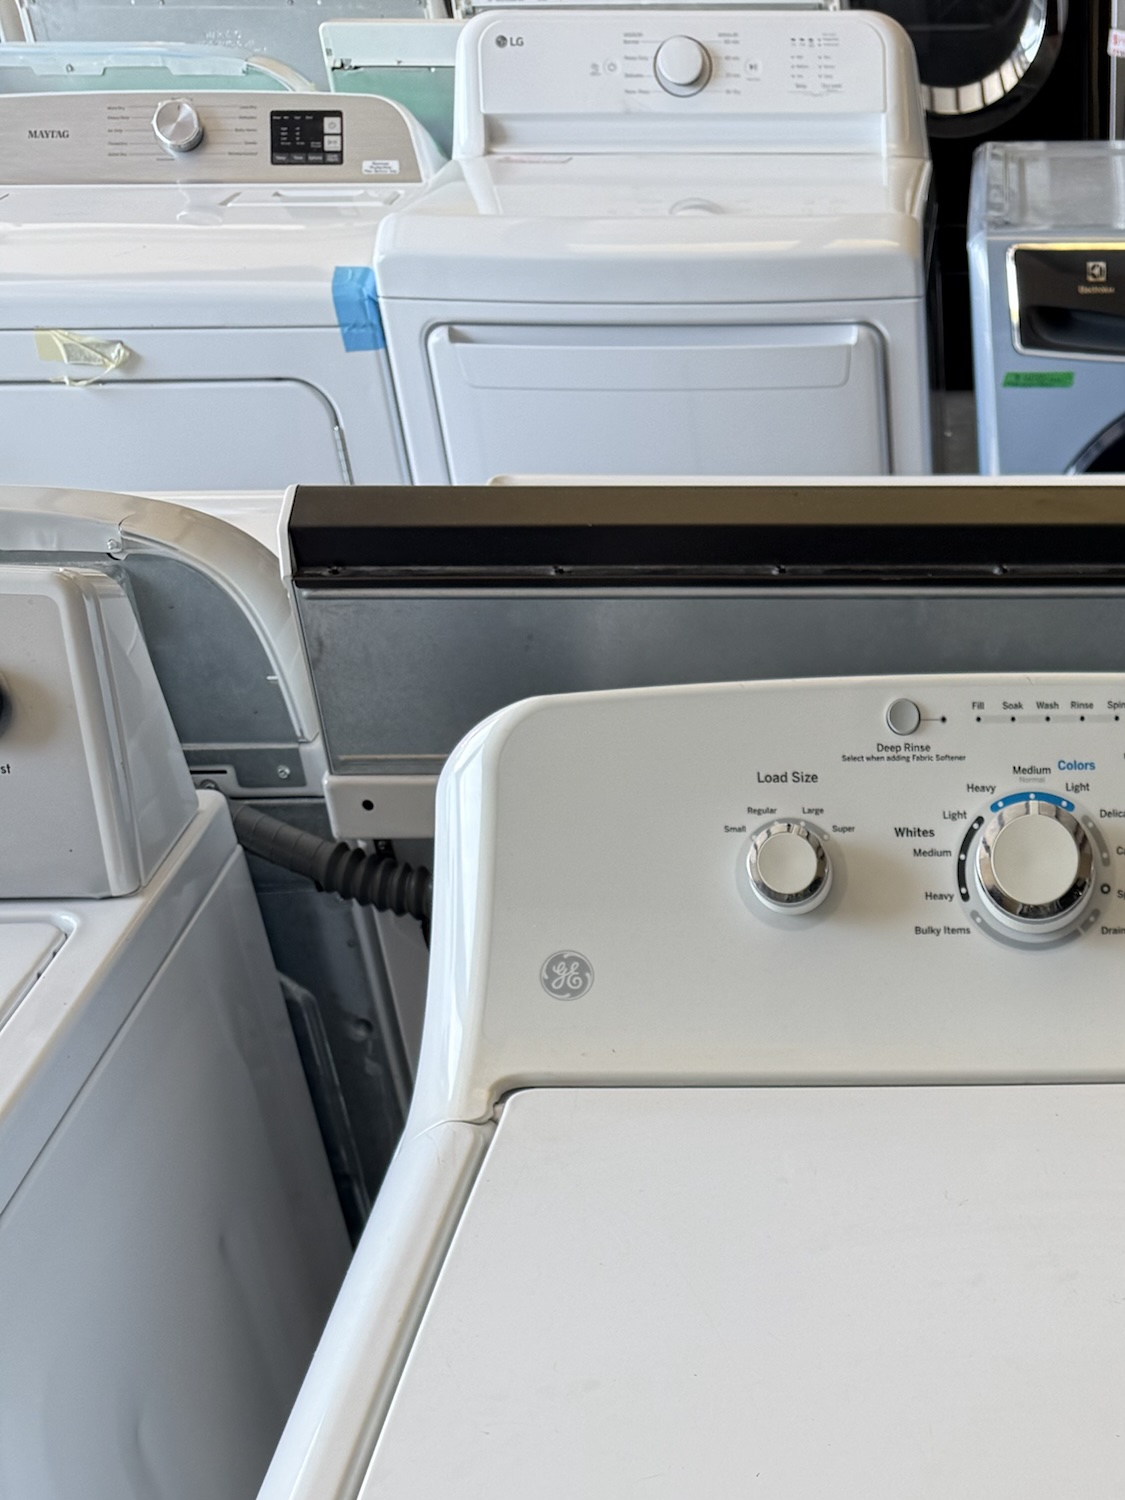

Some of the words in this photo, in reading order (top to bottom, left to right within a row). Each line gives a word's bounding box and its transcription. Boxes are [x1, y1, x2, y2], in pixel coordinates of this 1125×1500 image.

[510, 36, 524, 46] LG
[27, 129, 70, 139] MAYTAG
[972, 701, 985, 710] Fill
[1002, 701, 1024, 710] Soak
[1036, 701, 1060, 710] Wash
[1070, 701, 1094, 710] Rinse
[1107, 700, 1125, 711] Spin
[876, 743, 902, 754] Deep
[904, 743, 931, 752] Rinse
[841, 754, 864, 762] Select
[865, 754, 884, 762] when
[886, 754, 911, 764] adding
[912, 754, 933, 762] Fabric
[935, 754, 966, 762] Softener
[1012, 765, 1051, 775] Medium
[1057, 760, 1096, 771] Colors
[757, 771, 788, 783] Load
[791, 771, 819, 783] Size
[967, 783, 996, 794] Heavy
[1065, 782, 1090, 793] Light
[747, 806, 777, 816] Regular
[802, 806, 824, 816] Large
[943, 810, 968, 821] Light
[724, 824, 747, 833] Small
[832, 825, 855, 835] Super
[894, 827, 936, 838] Whites
[913, 848, 952, 858] Medium
[925, 892, 954, 902] Heavy
[914, 926, 941, 937] Bulky
[943, 926, 971, 935] Items
[1101, 925, 1125, 935] Drain
